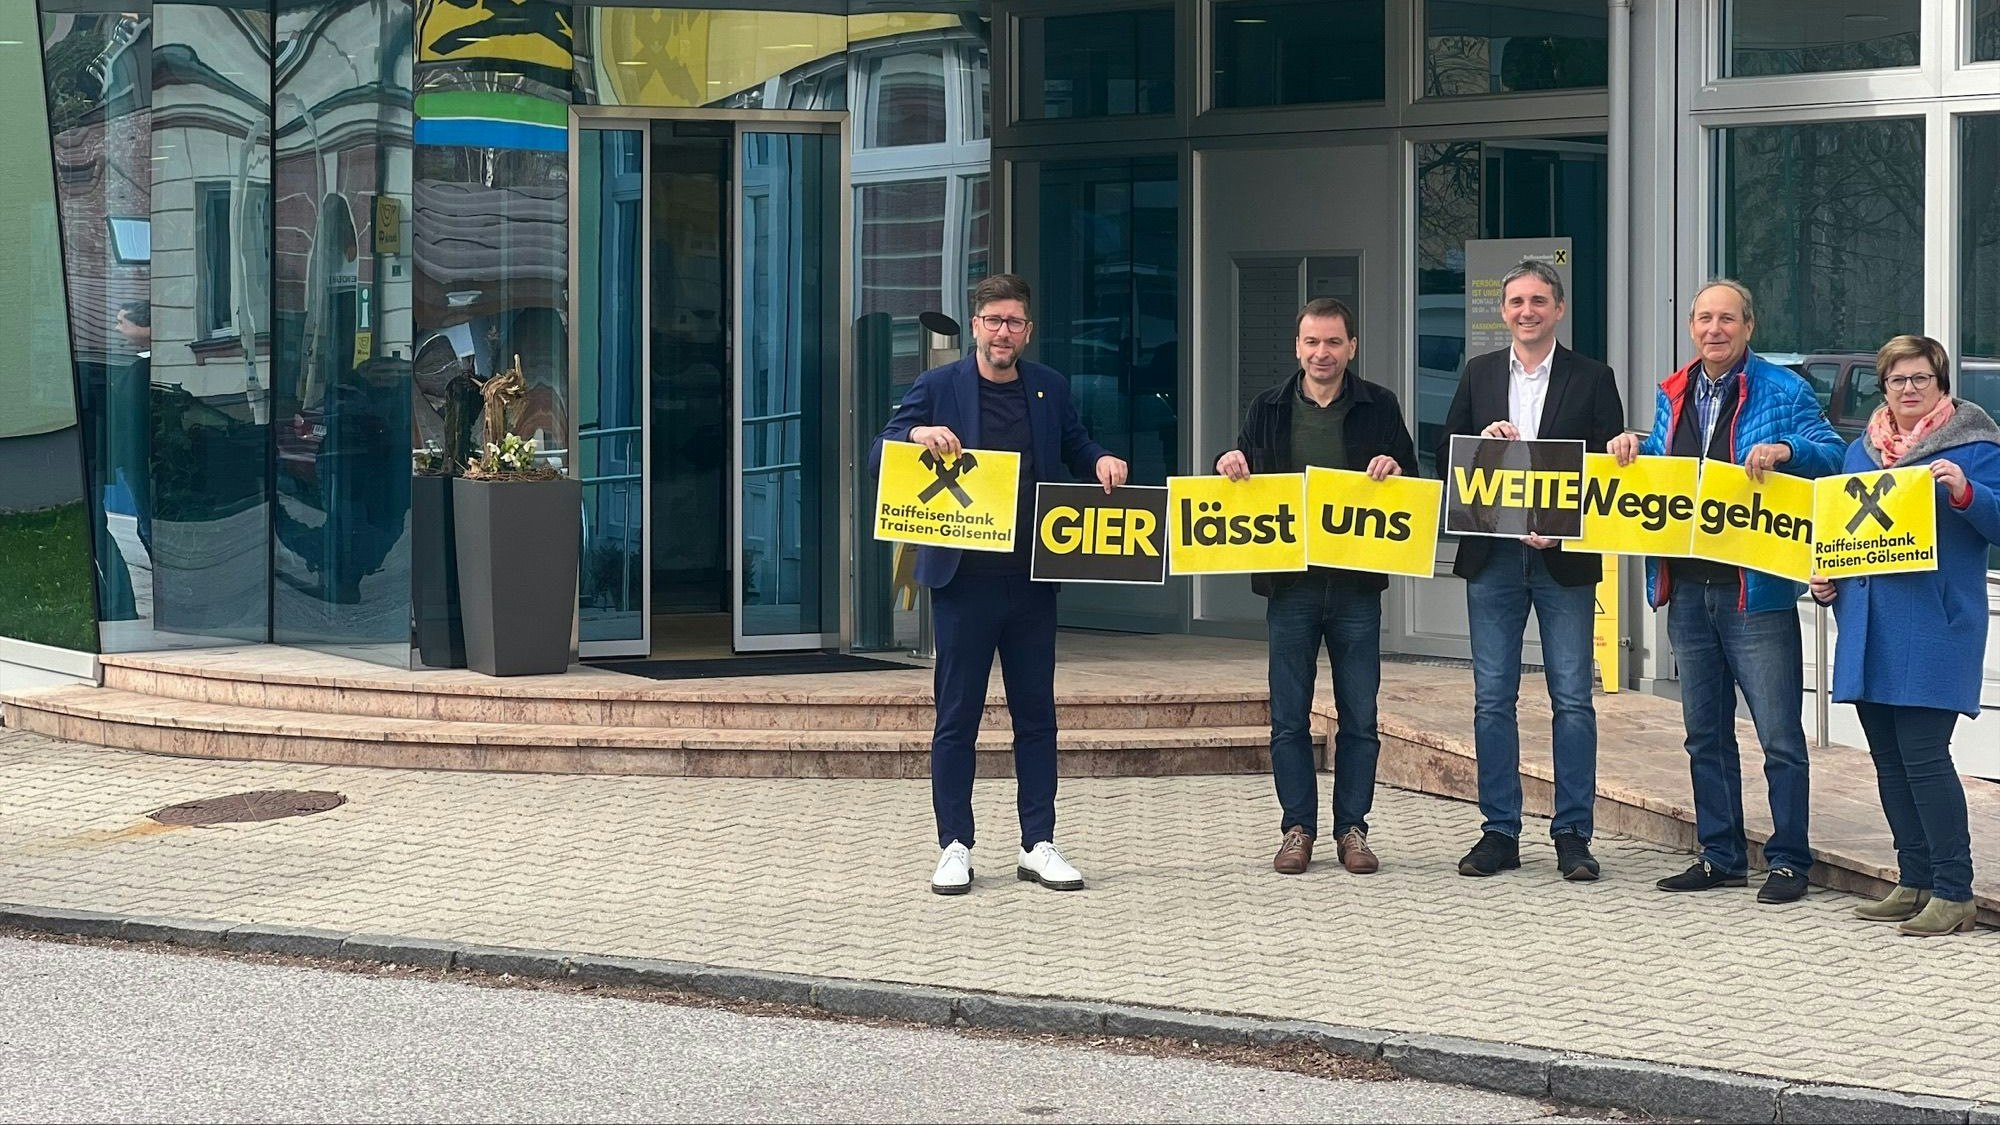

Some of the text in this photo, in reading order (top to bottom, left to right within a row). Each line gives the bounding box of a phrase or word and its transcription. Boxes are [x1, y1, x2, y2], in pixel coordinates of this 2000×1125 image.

[1453, 466, 1580, 510] WEITE
[1583, 477, 1694, 531] Wege
[880, 518, 1012, 541] Traisen-Gölsental
[881, 503, 994, 526] Raiffeisenbank
[1040, 505, 1160, 557] GIER
[1181, 498, 1297, 546] lässt
[1321, 503, 1412, 542] uns
[1699, 492, 1813, 544] gehen
[1816, 532, 1915, 554] Raiffeisenbank
[1816, 546, 1934, 569] Traisen-Gölsental
